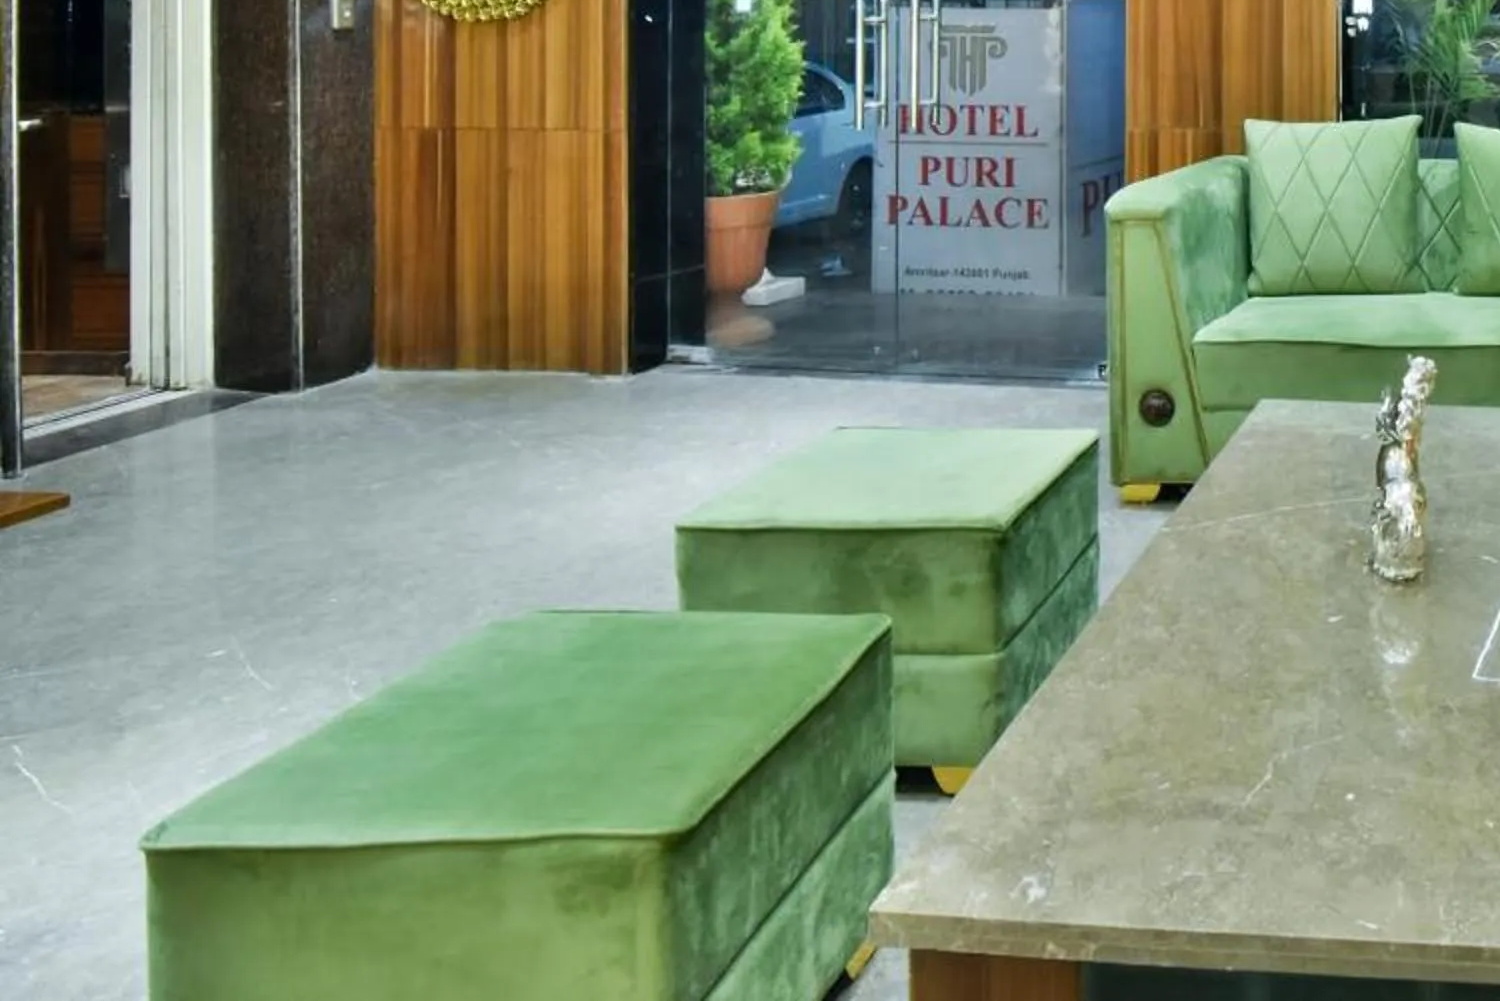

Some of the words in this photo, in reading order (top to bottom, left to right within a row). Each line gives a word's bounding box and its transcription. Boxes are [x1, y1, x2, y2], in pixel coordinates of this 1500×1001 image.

[899, 103, 1039, 137] HOTEL
[918, 156, 1016, 187] PURI
[886, 195, 1050, 229] PALACE
